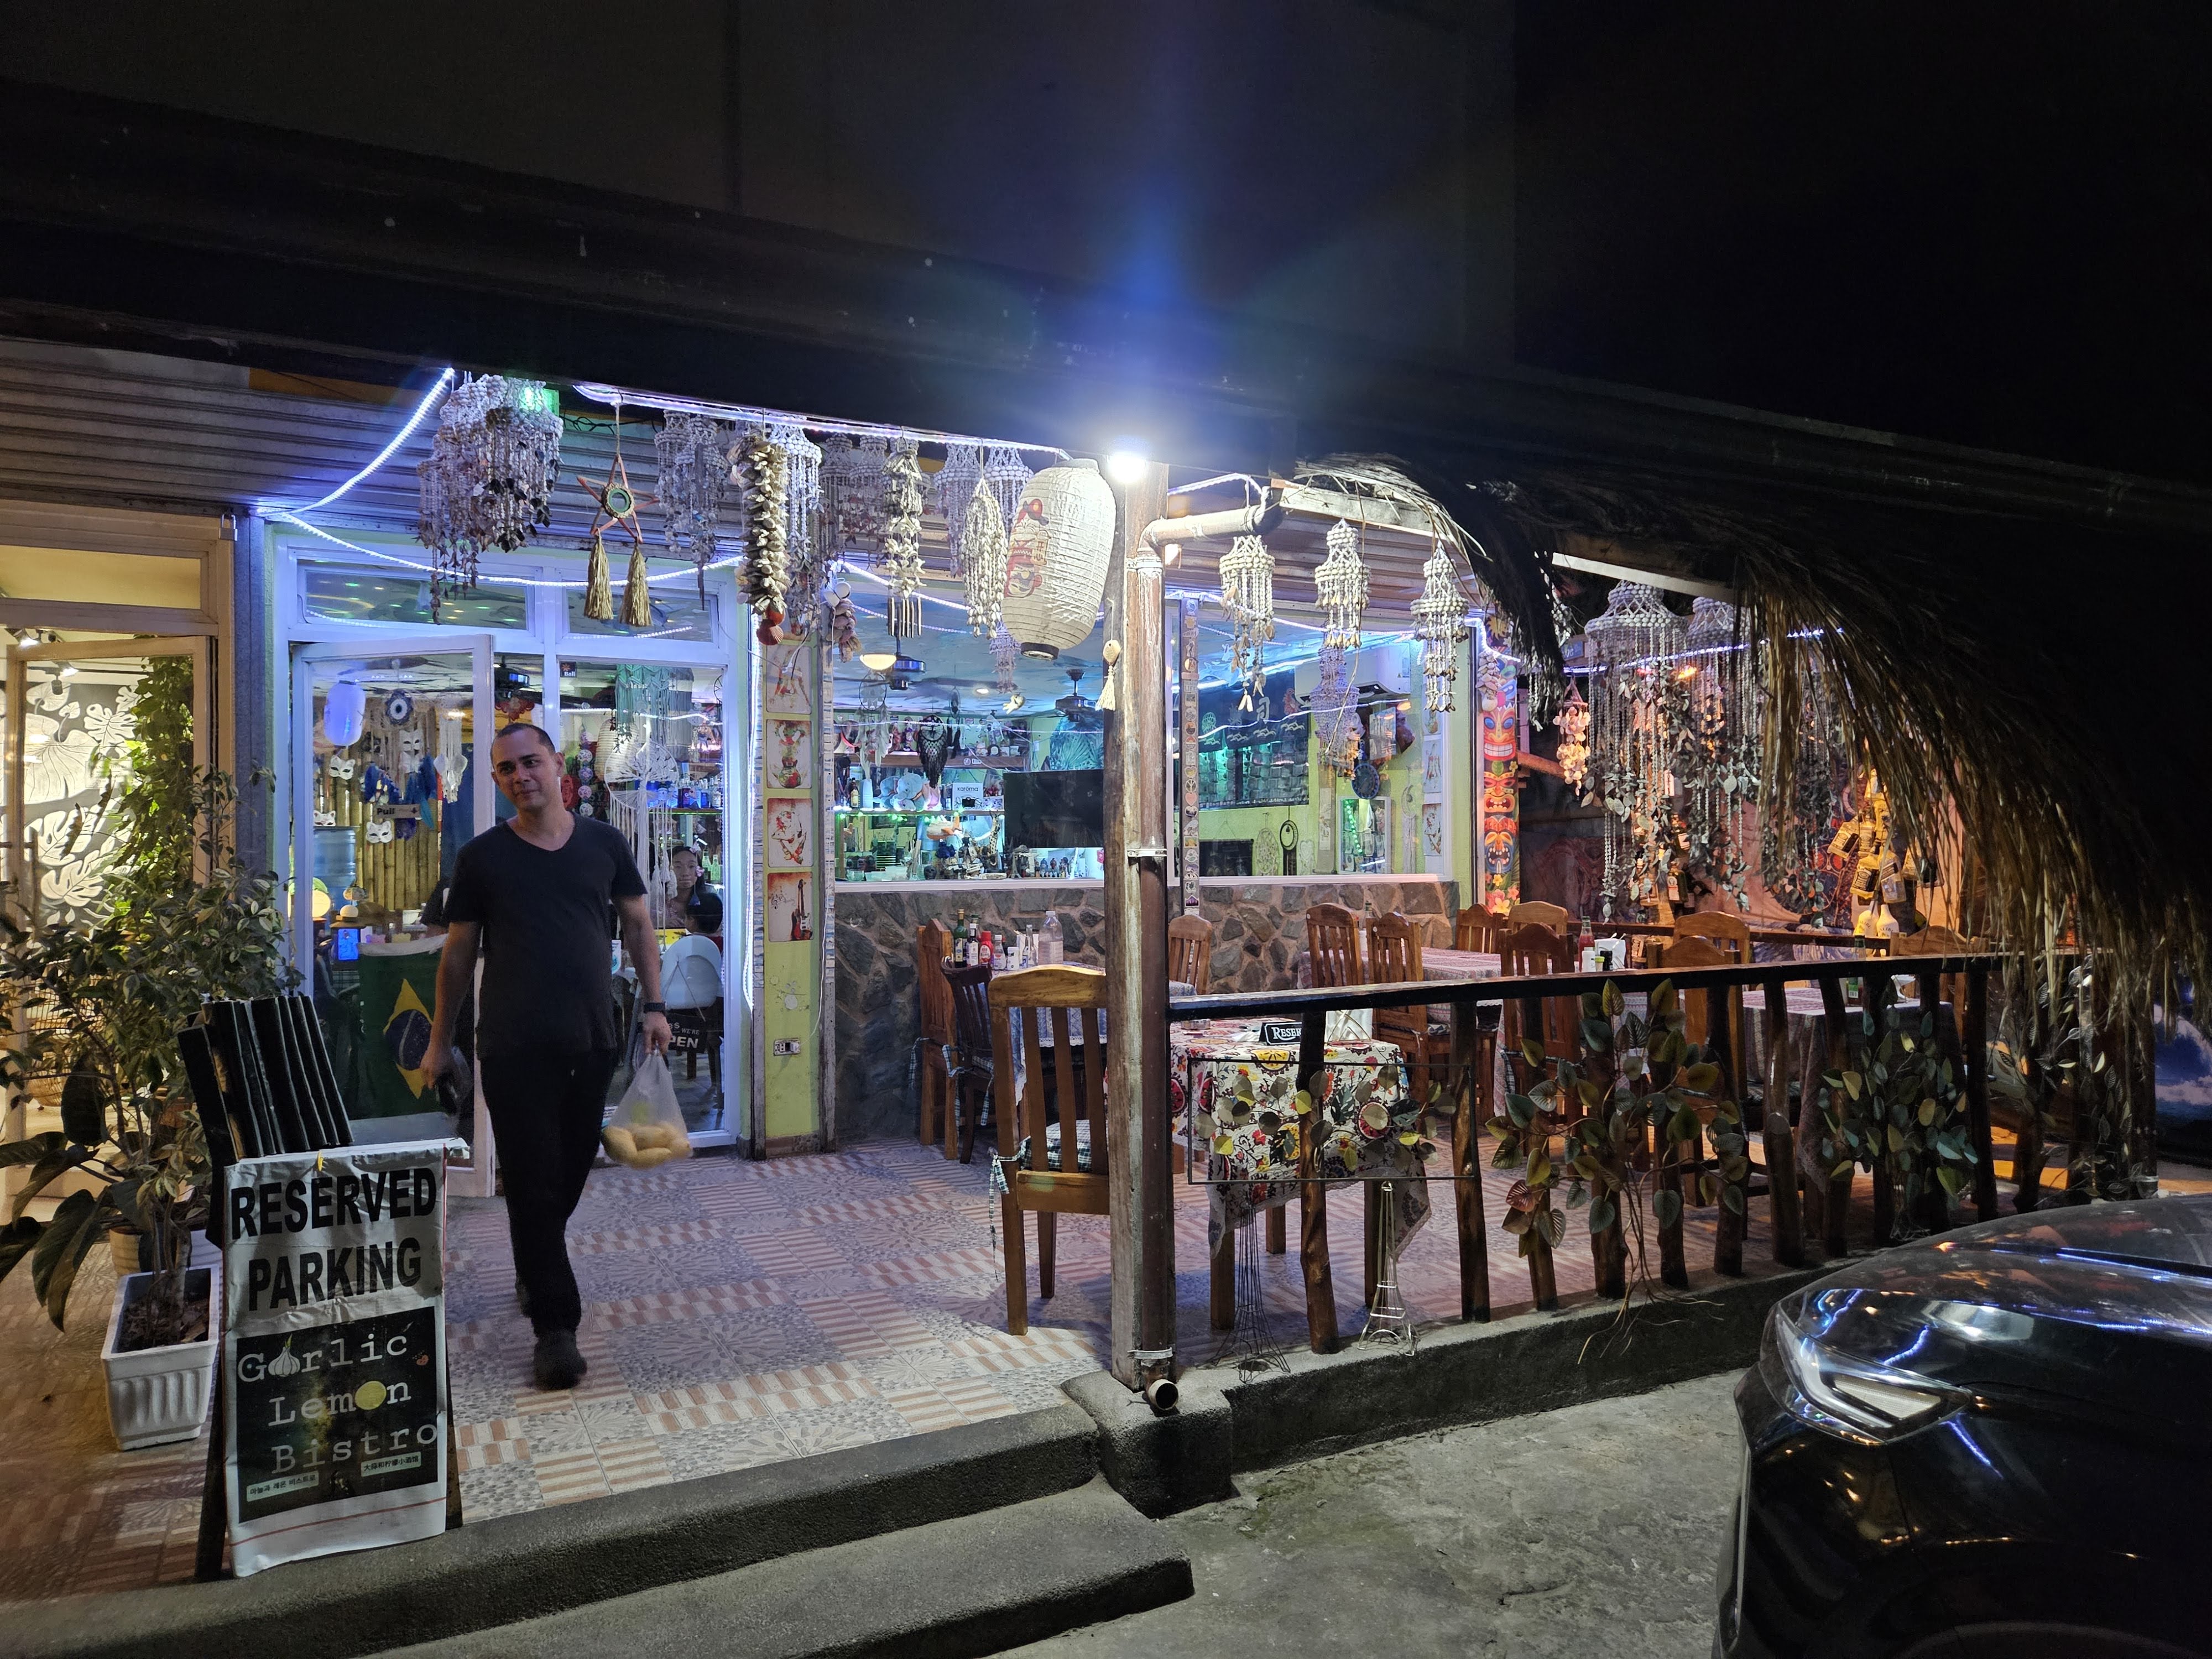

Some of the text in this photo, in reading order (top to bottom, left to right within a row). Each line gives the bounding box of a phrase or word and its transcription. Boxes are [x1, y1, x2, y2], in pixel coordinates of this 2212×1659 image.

[1271, 1027, 1301, 1041] RESER
[231, 1167, 436, 1240] RESERVED
[249, 1238, 421, 1311] PARKING
[272, 1424, 437, 1474] Bistro
